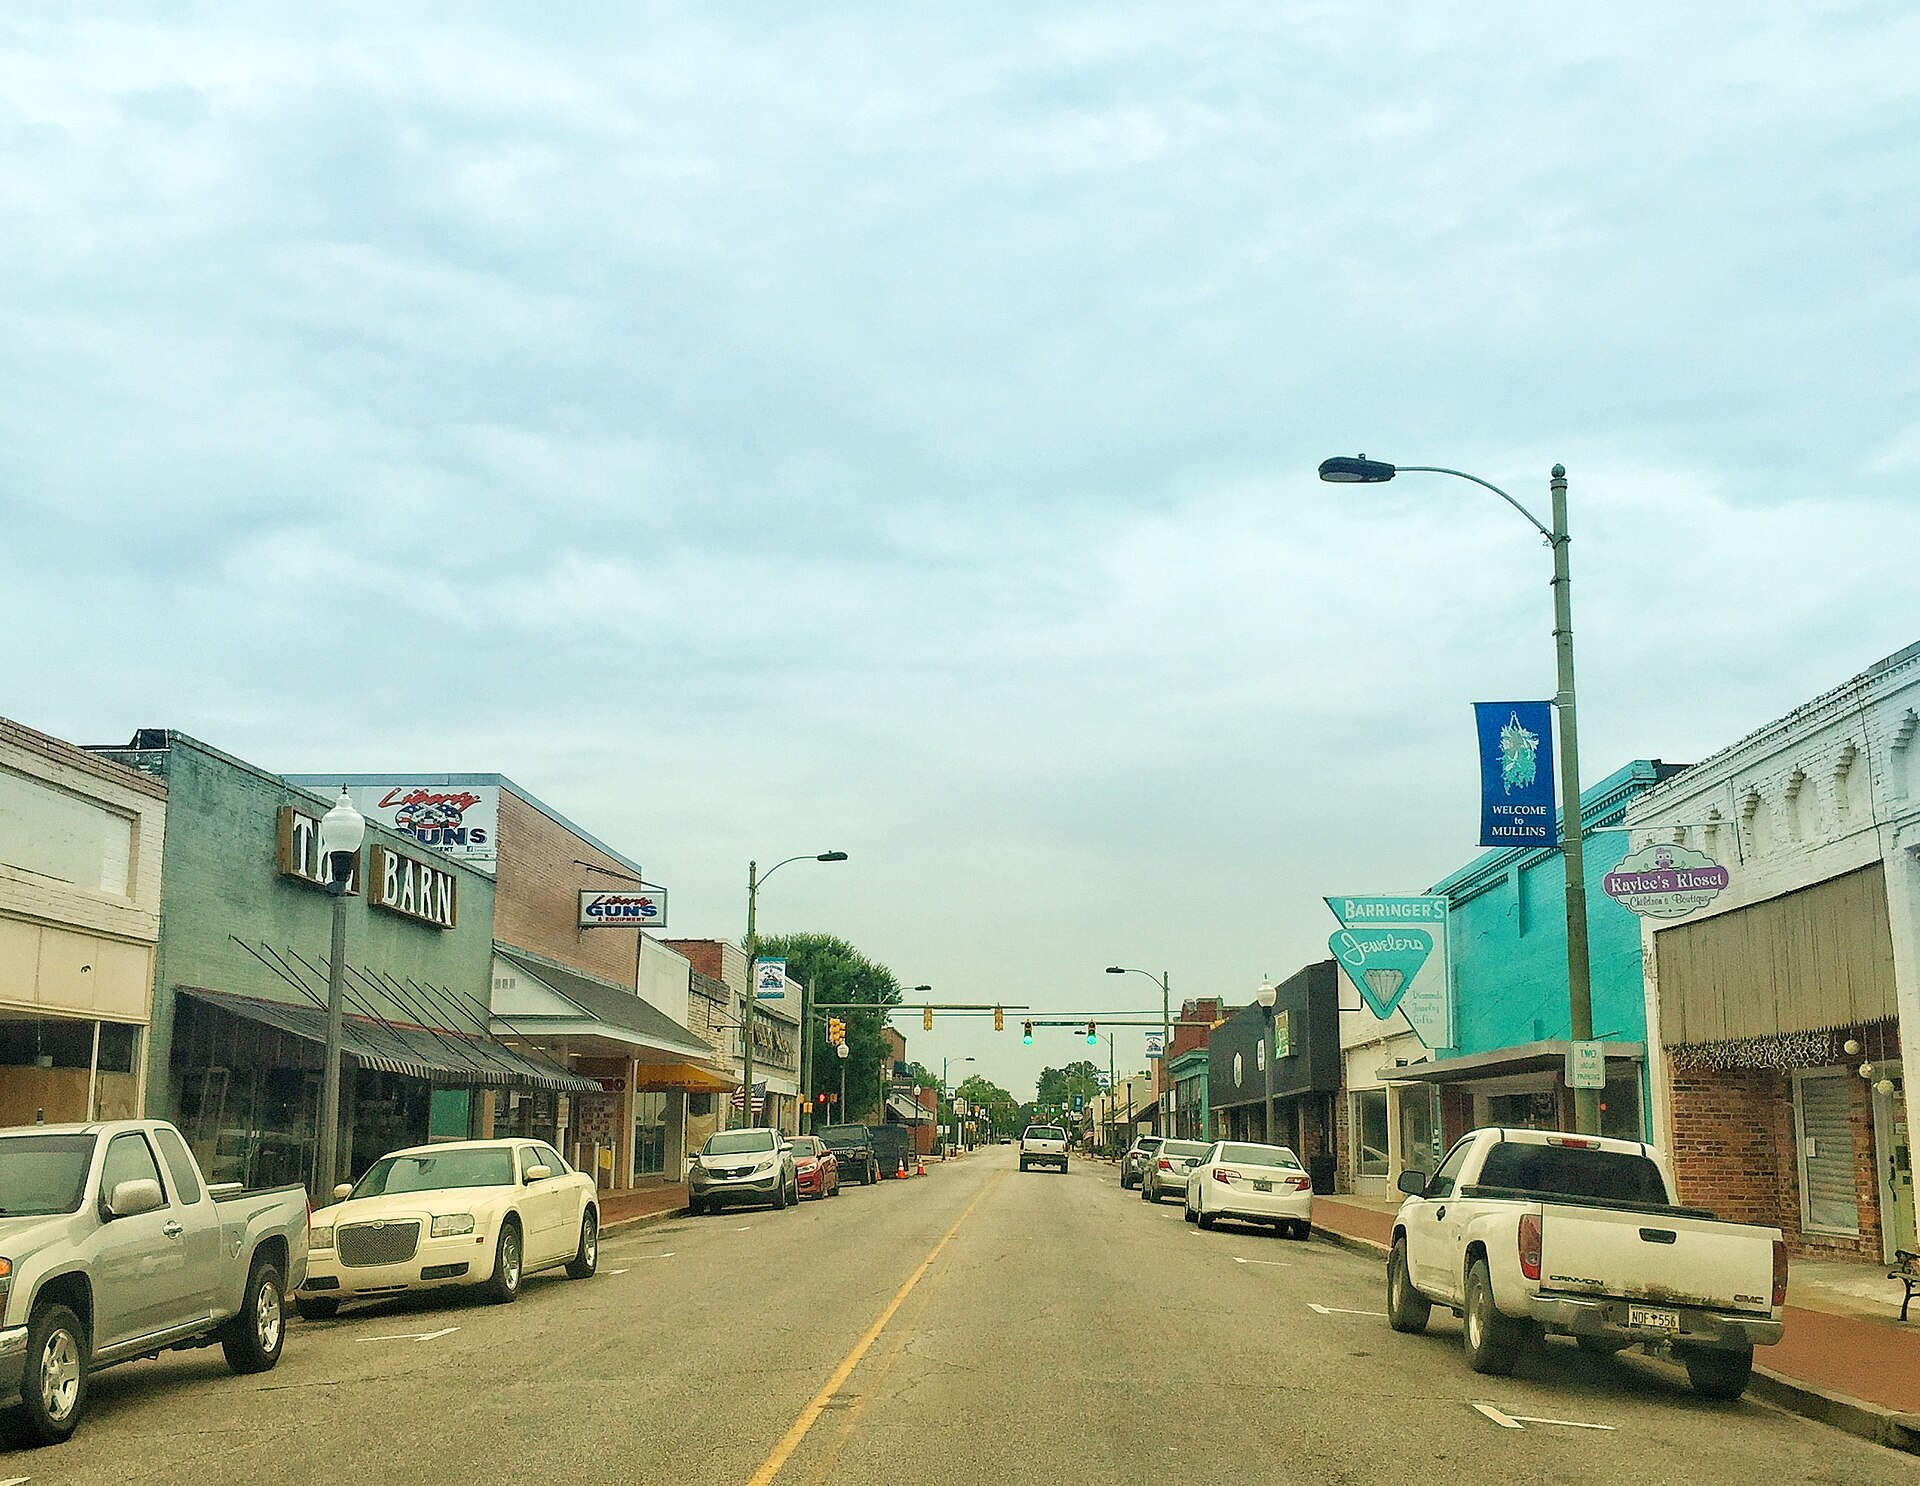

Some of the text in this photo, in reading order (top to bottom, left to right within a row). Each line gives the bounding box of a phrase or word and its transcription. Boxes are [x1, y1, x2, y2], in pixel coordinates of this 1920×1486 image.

[378, 787, 481, 813] Liberty
[1492, 805, 1547, 815] WELCOME
[1514, 817, 1524, 825] to
[1491, 826, 1546, 836] MULLINS
[293, 811, 453, 926] TH BARN
[1611, 872, 1723, 895] Kaylee's Kloset
[585, 905, 658, 917] GUNS
[1344, 900, 1445, 919] BARRINGER'S
[1340, 932, 1424, 966] Jewelers
[1580, 1049, 1597, 1058] TWO
[1549, 1274, 1604, 1286] CANYON
[1733, 1293, 1764, 1304] GMC
